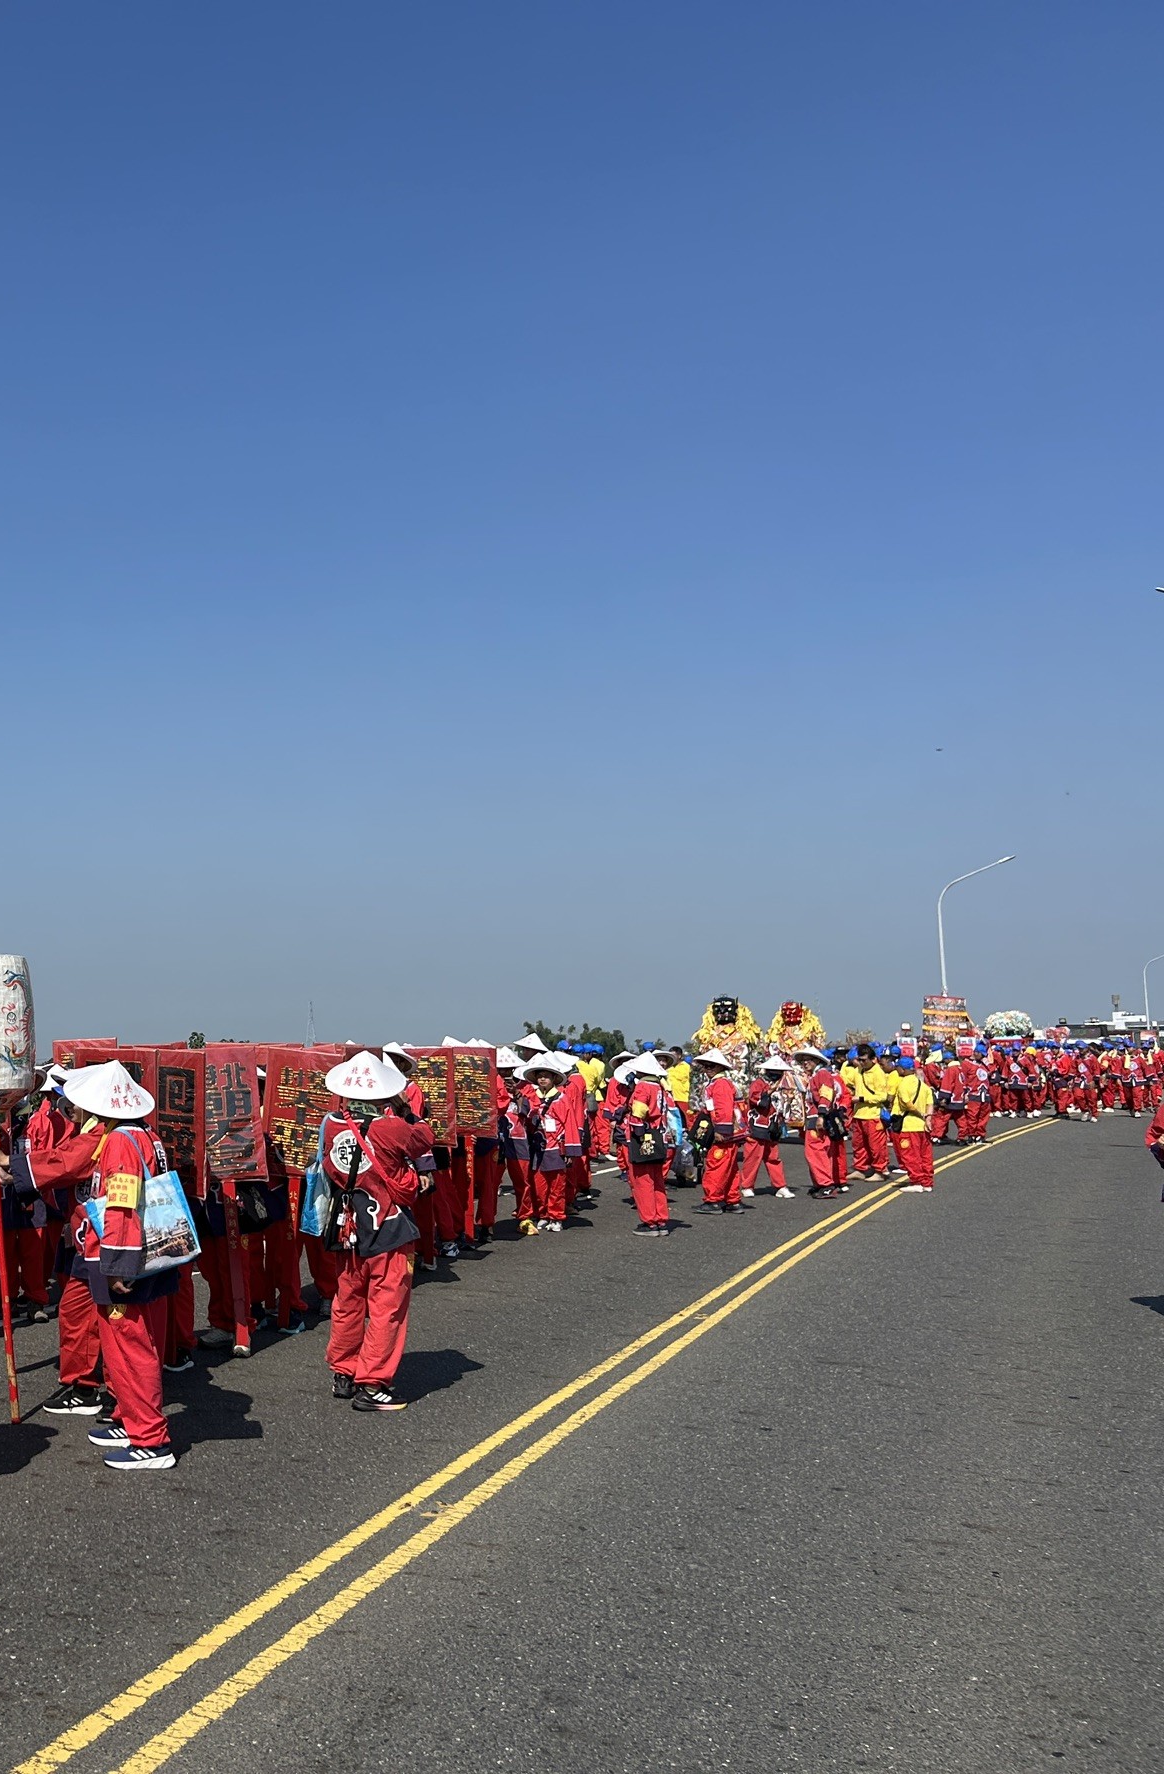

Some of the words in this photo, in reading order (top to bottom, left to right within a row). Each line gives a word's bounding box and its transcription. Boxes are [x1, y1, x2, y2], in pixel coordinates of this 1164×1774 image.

[352, 1066, 371, 1076] 北港
[342, 1077, 377, 1089] 朝天宮
